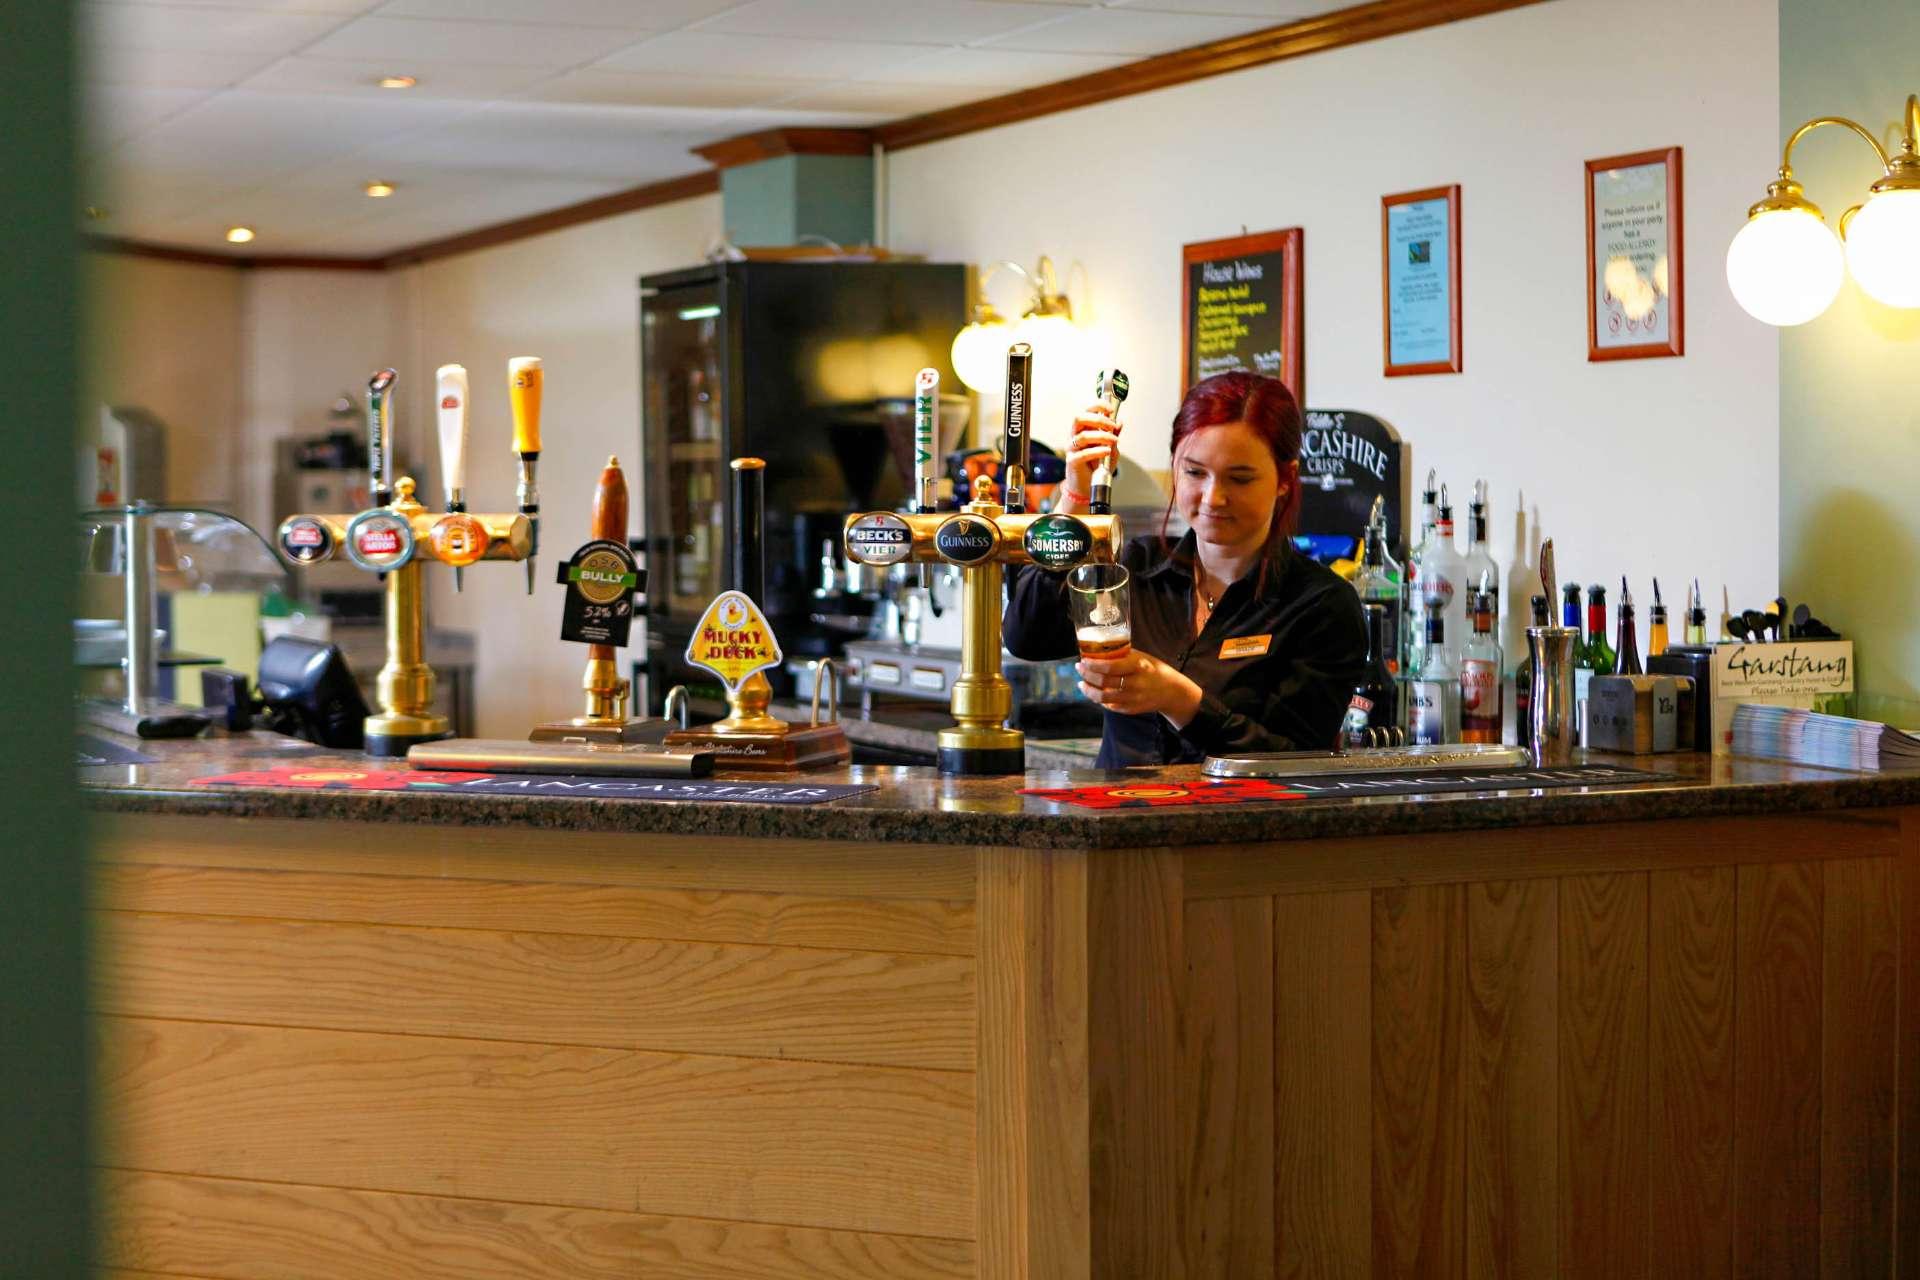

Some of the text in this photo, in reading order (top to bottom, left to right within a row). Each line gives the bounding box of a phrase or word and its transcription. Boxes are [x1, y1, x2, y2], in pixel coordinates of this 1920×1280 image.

[1008, 382, 1023, 437] GUINNESS
[915, 395, 933, 466] VIER
[1307, 456, 1345, 475] CRISPS
[856, 529, 904, 542] BECK'S
[940, 535, 990, 548] GUINNESS
[863, 545, 896, 555] VIER
[1031, 539, 1084, 552] SOMERSBY
[581, 570, 625, 583] BULLY
[703, 630, 762, 644] MUCKY
[1728, 646, 1847, 688] Garstang
[464, 778, 828, 796] LANCASTER
